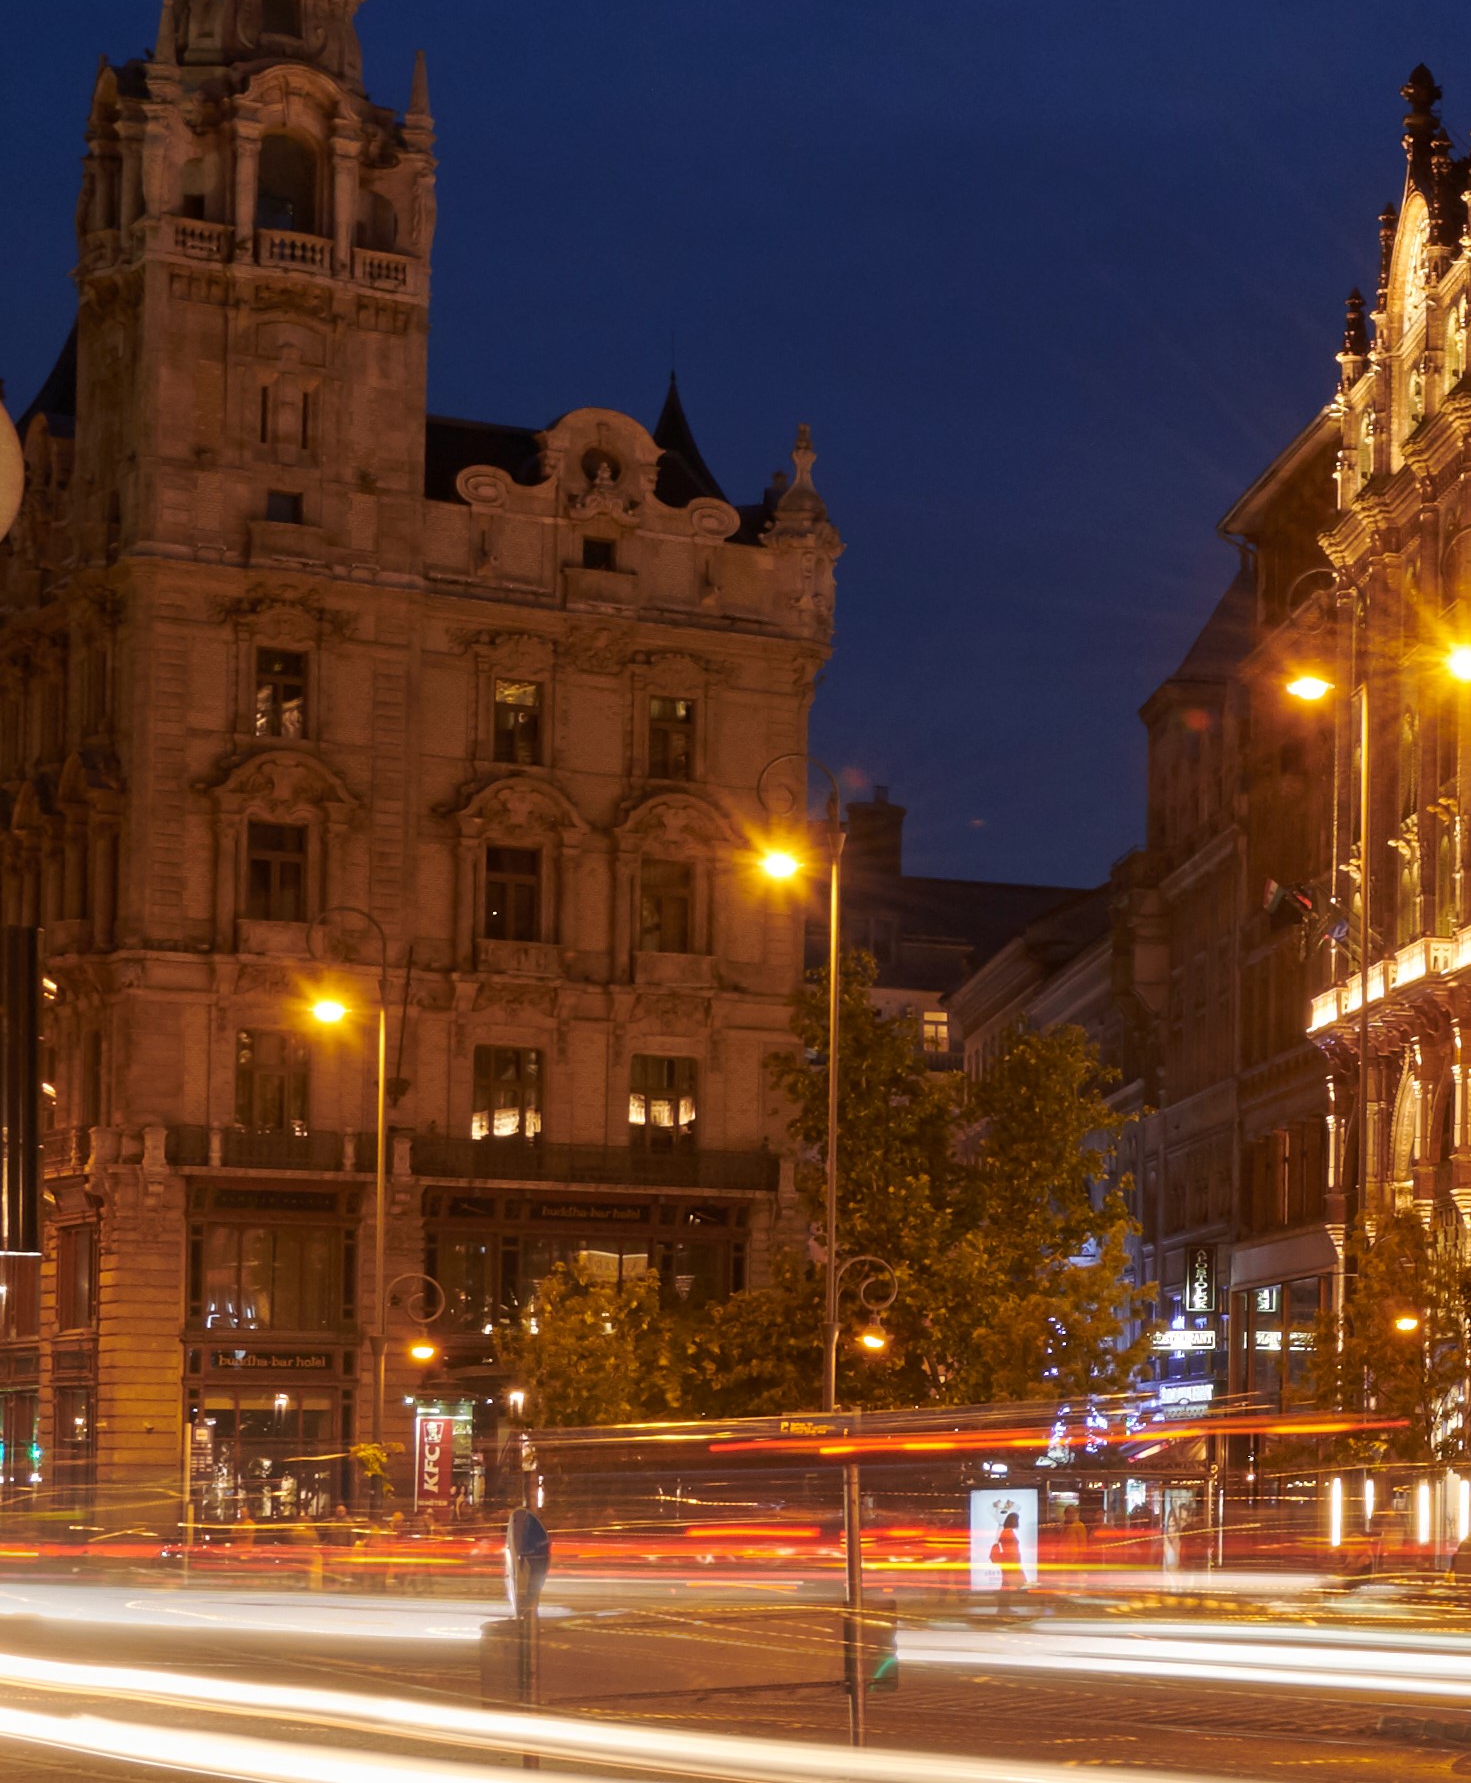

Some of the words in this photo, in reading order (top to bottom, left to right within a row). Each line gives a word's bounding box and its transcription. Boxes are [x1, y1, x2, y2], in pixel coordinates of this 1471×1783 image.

[542, 1205, 611, 1217] buddha-bar
[613, 1208, 641, 1218] hotel
[219, 1355, 294, 1367] buddha-bar
[296, 1355, 326, 1367] hotel
[423, 1444, 441, 1494] KFC
